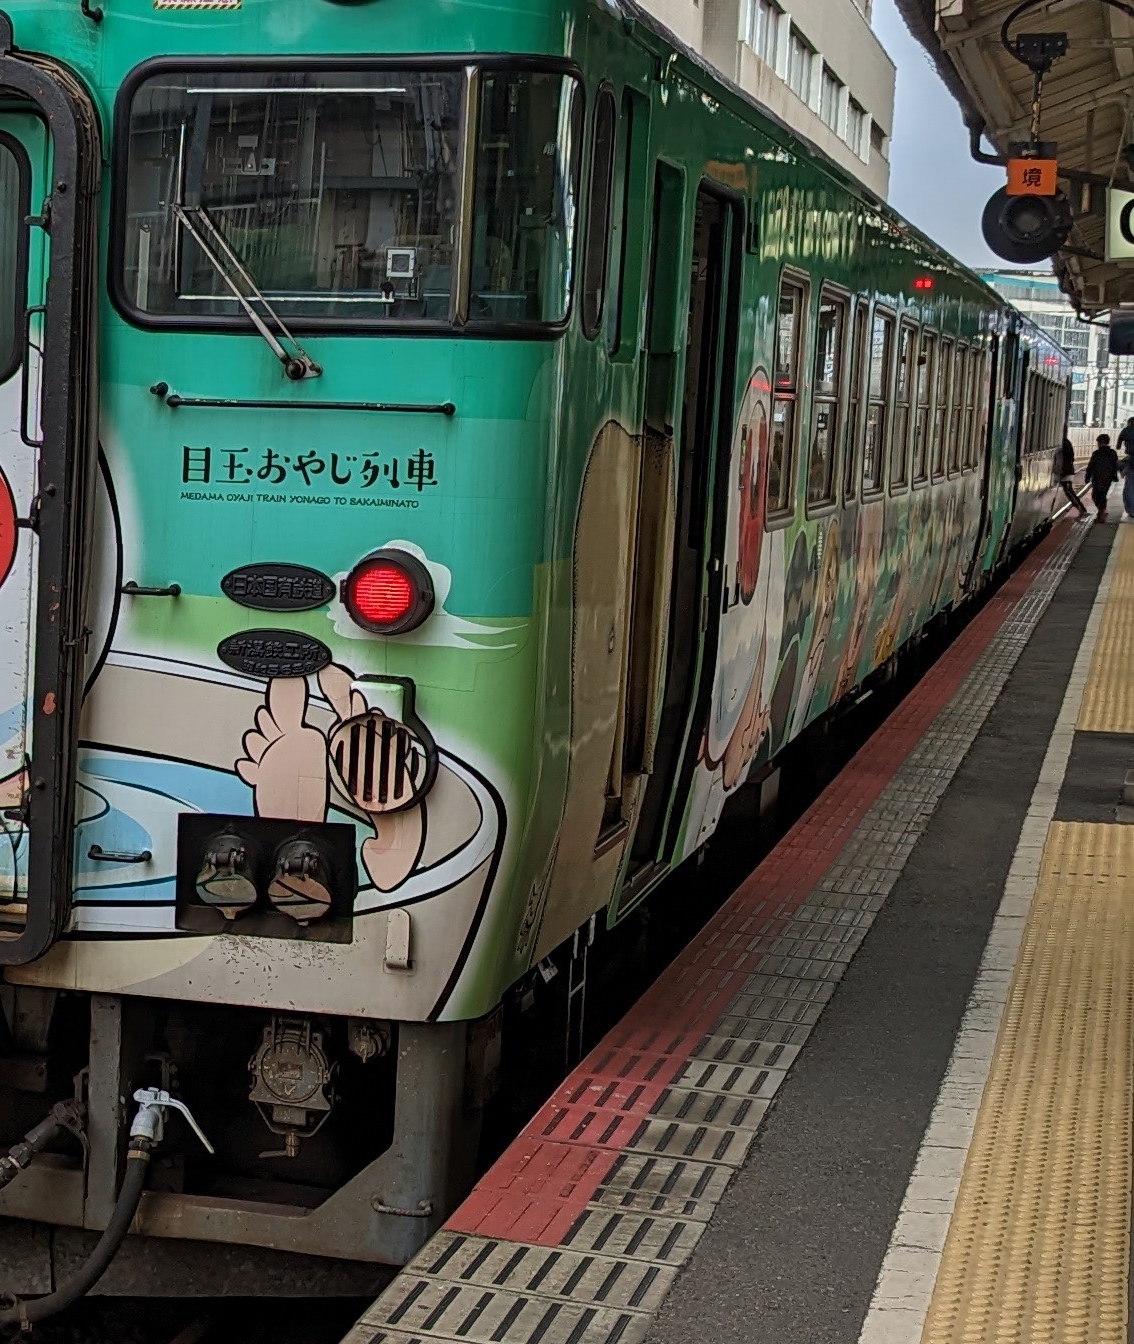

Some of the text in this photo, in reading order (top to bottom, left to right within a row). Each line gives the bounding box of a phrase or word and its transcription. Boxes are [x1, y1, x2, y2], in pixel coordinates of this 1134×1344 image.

[1022, 167, 1042, 188] 境
[182, 446, 438, 492] 目玉おやじ列車
[180, 492, 419, 509] MEDAMA OYAJI TRAIN YONAGO TO SAKAIMINATO
